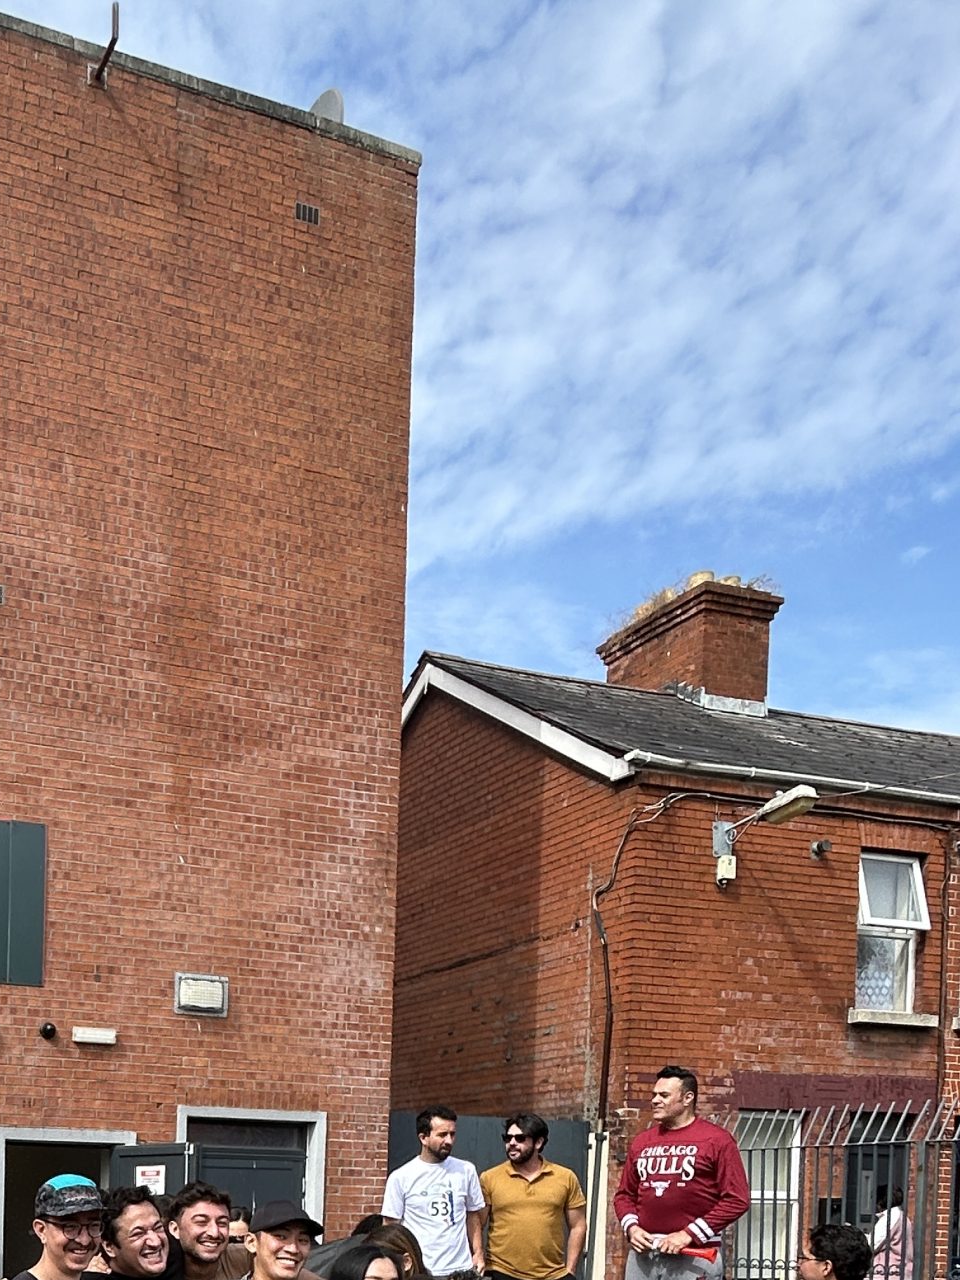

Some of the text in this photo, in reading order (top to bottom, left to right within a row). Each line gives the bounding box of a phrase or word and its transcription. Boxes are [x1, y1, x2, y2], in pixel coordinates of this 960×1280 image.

[641, 1145, 698, 1157] CHICAGO
[637, 1156, 695, 1182] BULLS
[431, 1201, 449, 1216] 53
